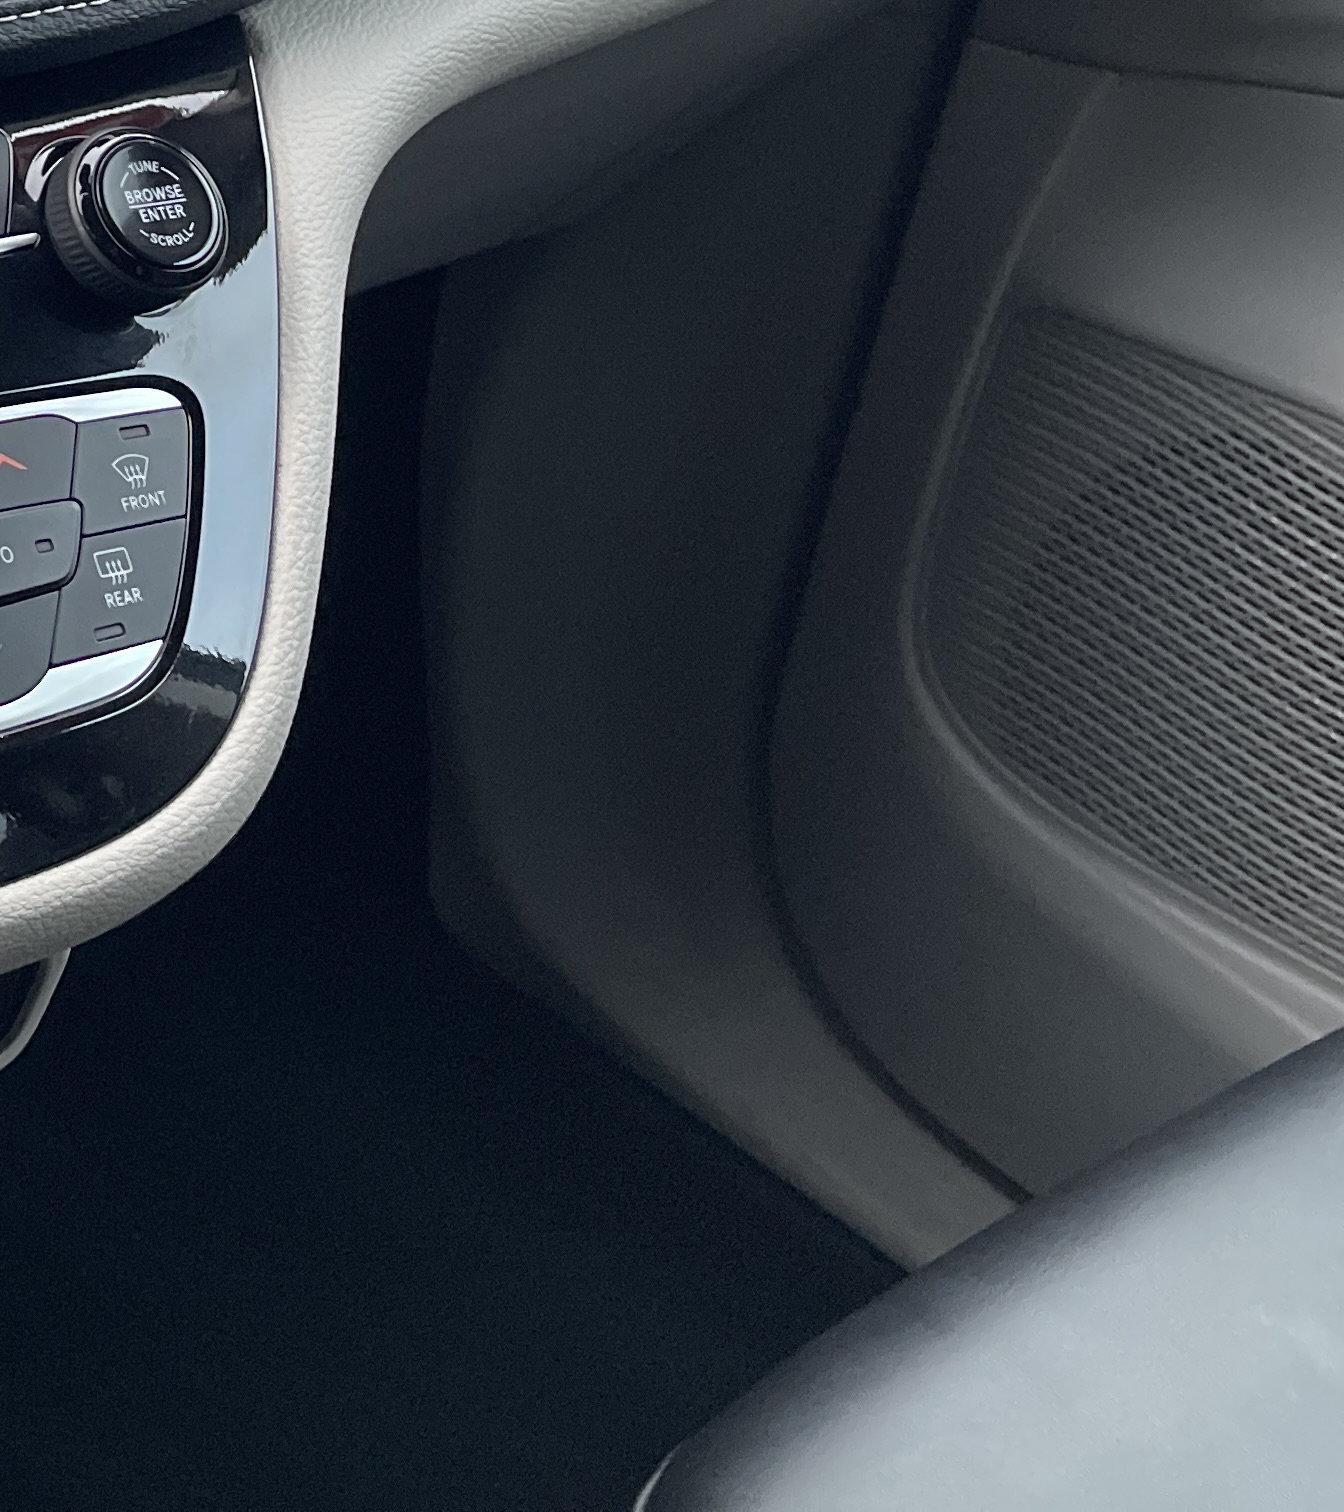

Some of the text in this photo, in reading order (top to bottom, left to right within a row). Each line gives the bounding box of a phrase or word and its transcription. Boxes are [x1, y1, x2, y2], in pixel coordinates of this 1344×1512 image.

[128, 160, 160, 176] TUNE
[124, 183, 185, 204] BROWSE
[138, 204, 187, 224] ENTER
[149, 228, 194, 247] SCROLL
[120, 490, 167, 512] FRONT
[104, 587, 144, 608] REAR
